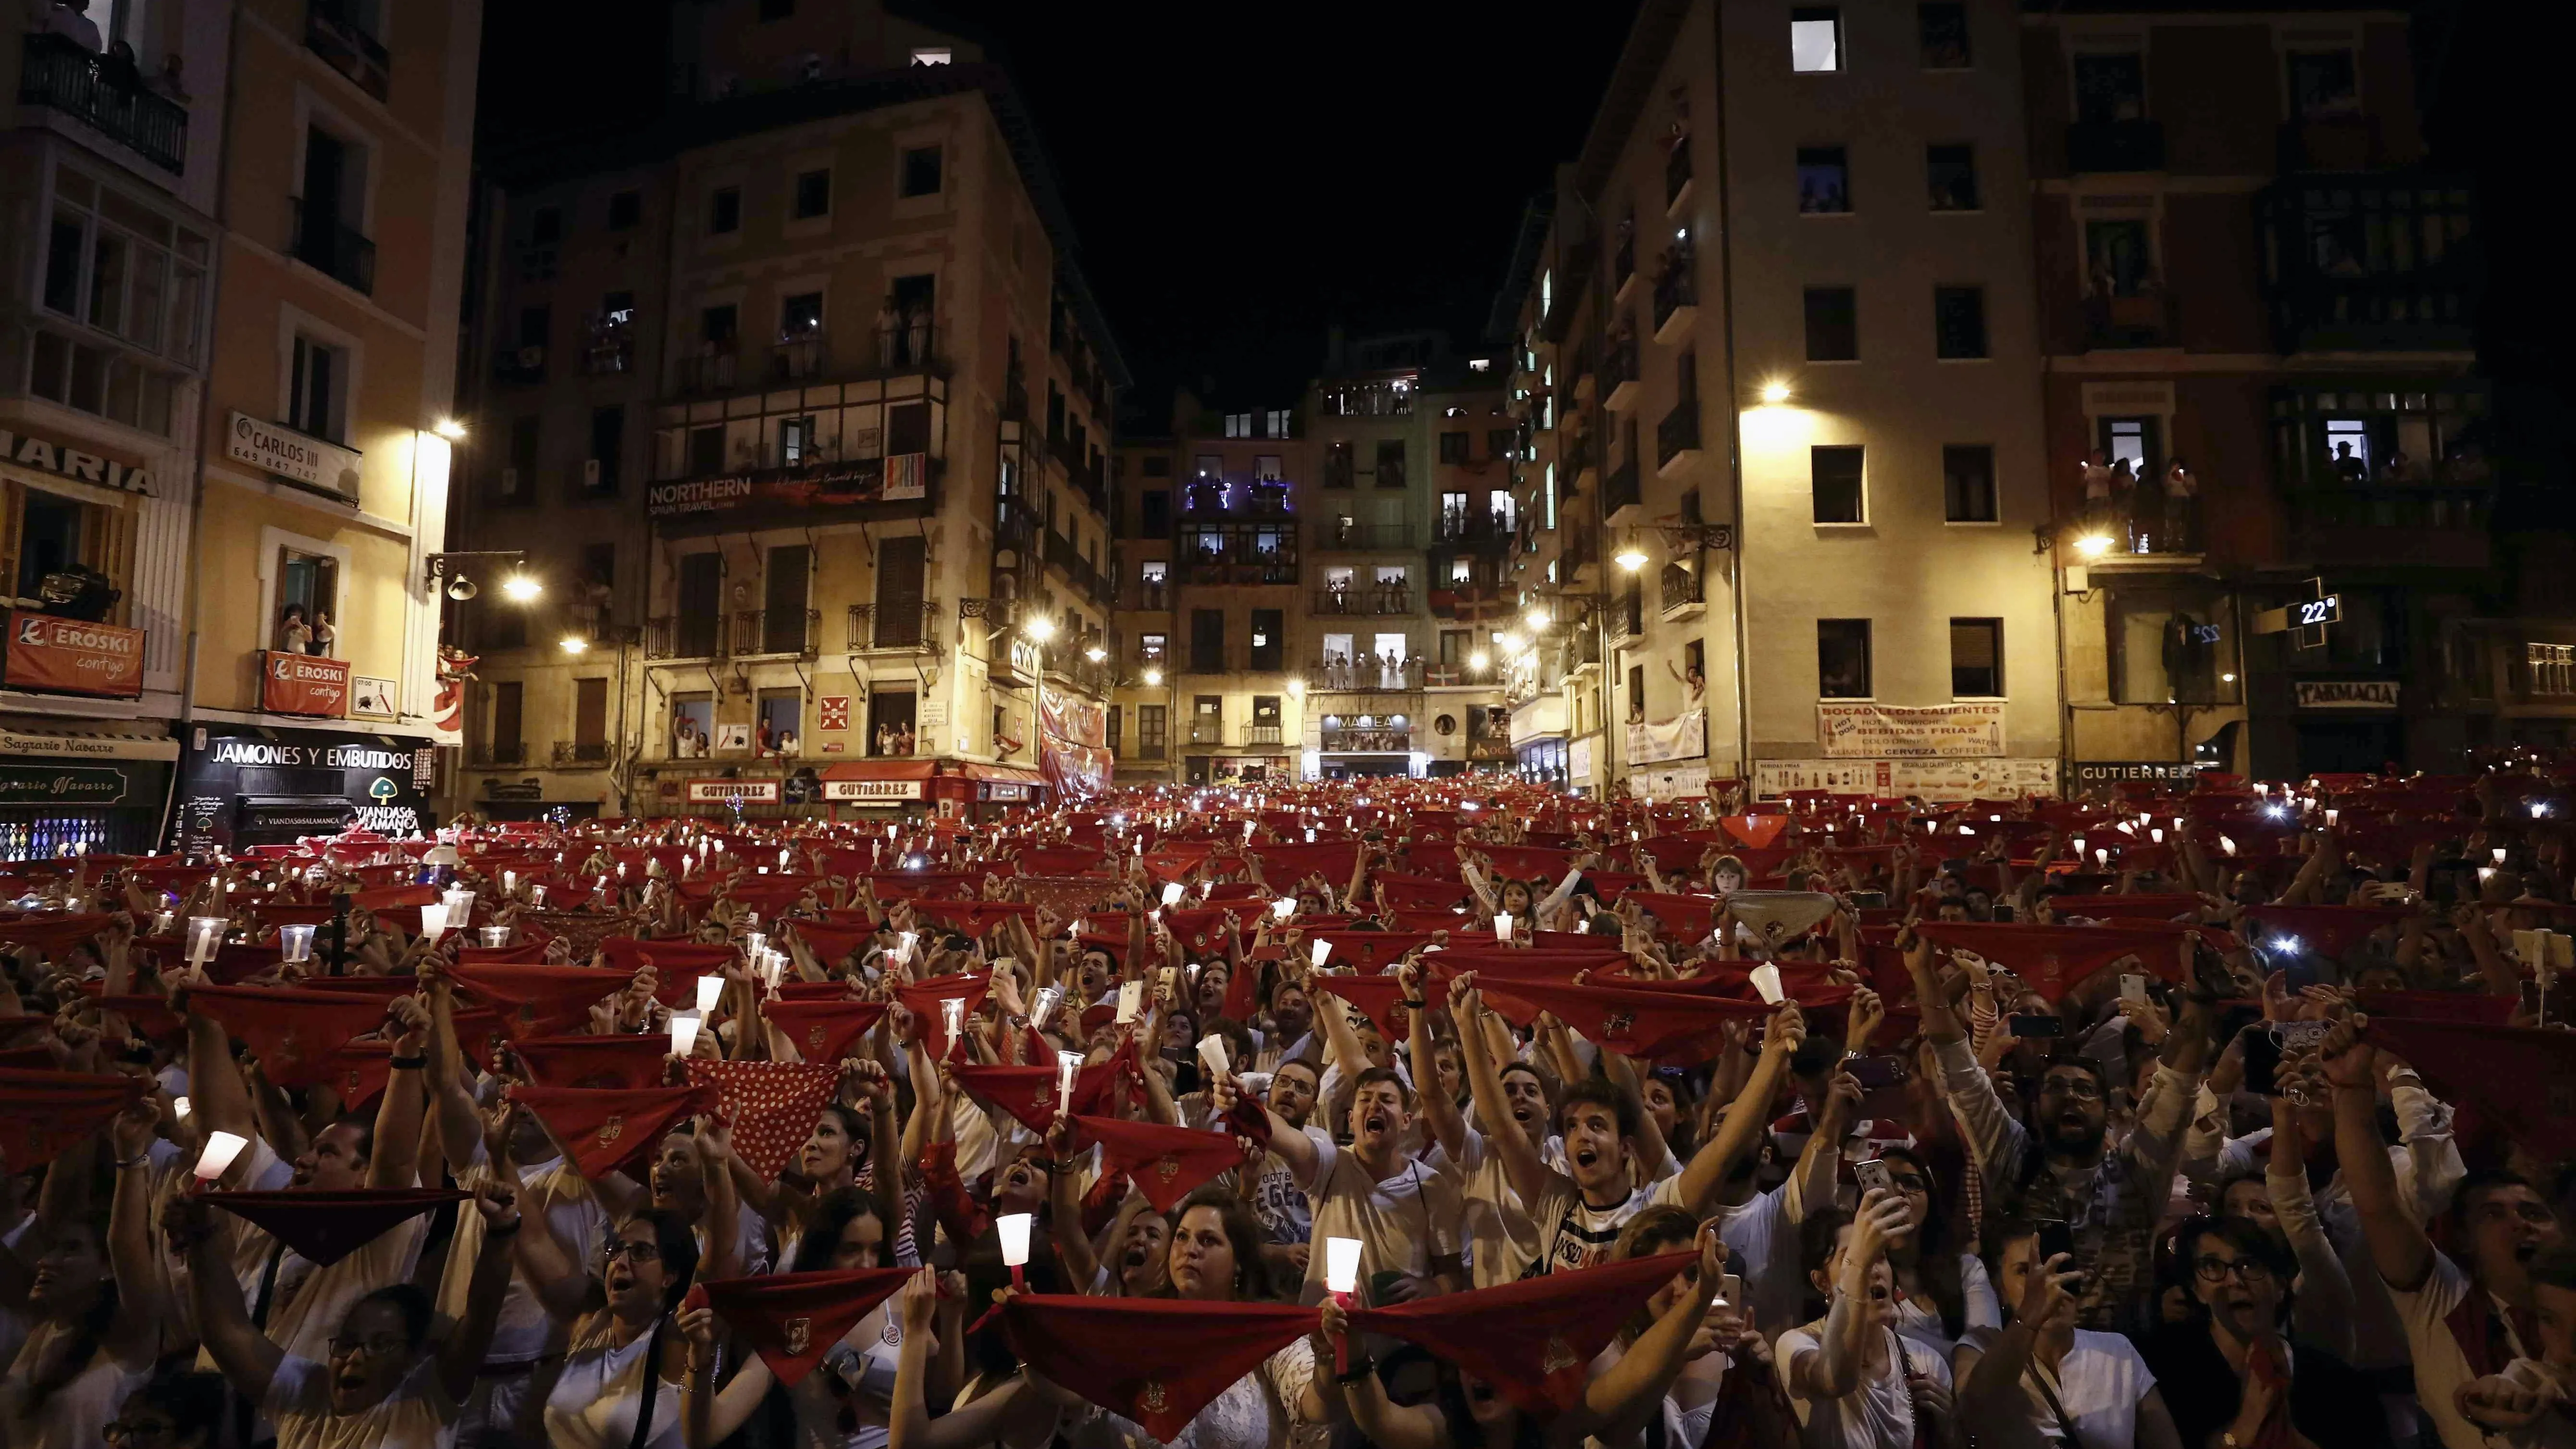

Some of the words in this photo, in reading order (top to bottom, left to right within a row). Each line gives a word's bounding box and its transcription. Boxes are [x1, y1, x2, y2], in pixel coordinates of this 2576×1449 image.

[254, 433, 304, 463] CARLOS
[308, 450, 318, 467] III
[234, 447, 258, 461] 649
[266, 458, 288, 471] 847
[650, 476, 751, 505] NORTHERN
[650, 504, 677, 516] SPAIN
[56, 629, 129, 652] EROSKI
[76, 656, 124, 680] contigo
[297, 665, 343, 681] EROSKI
[310, 685, 340, 703] contigo
[1920, 706, 2000, 715] CALIENTES
[1338, 715, 1393, 728] MALTEA
[1835, 718, 1851, 729] HOT
[1838, 725, 1856, 736] DOG
[4, 736, 60, 753] Sagrario
[64, 740, 114, 753] Navarro
[1968, 736, 1999, 747] WATER
[212, 743, 301, 765] JAMONES
[308, 748, 321, 765] Y
[327, 749, 413, 770] EMBUTIDOS
[2082, 767, 2192, 779] GUTIERREZ
[0, 781, 47, 793] grario
[50, 777, 115, 794] Navarro
[701, 786, 765, 797] GUTIERREZ
[839, 783, 908, 795] GUTIERREZ
[1262, 1172, 1292, 1183] OOTB
